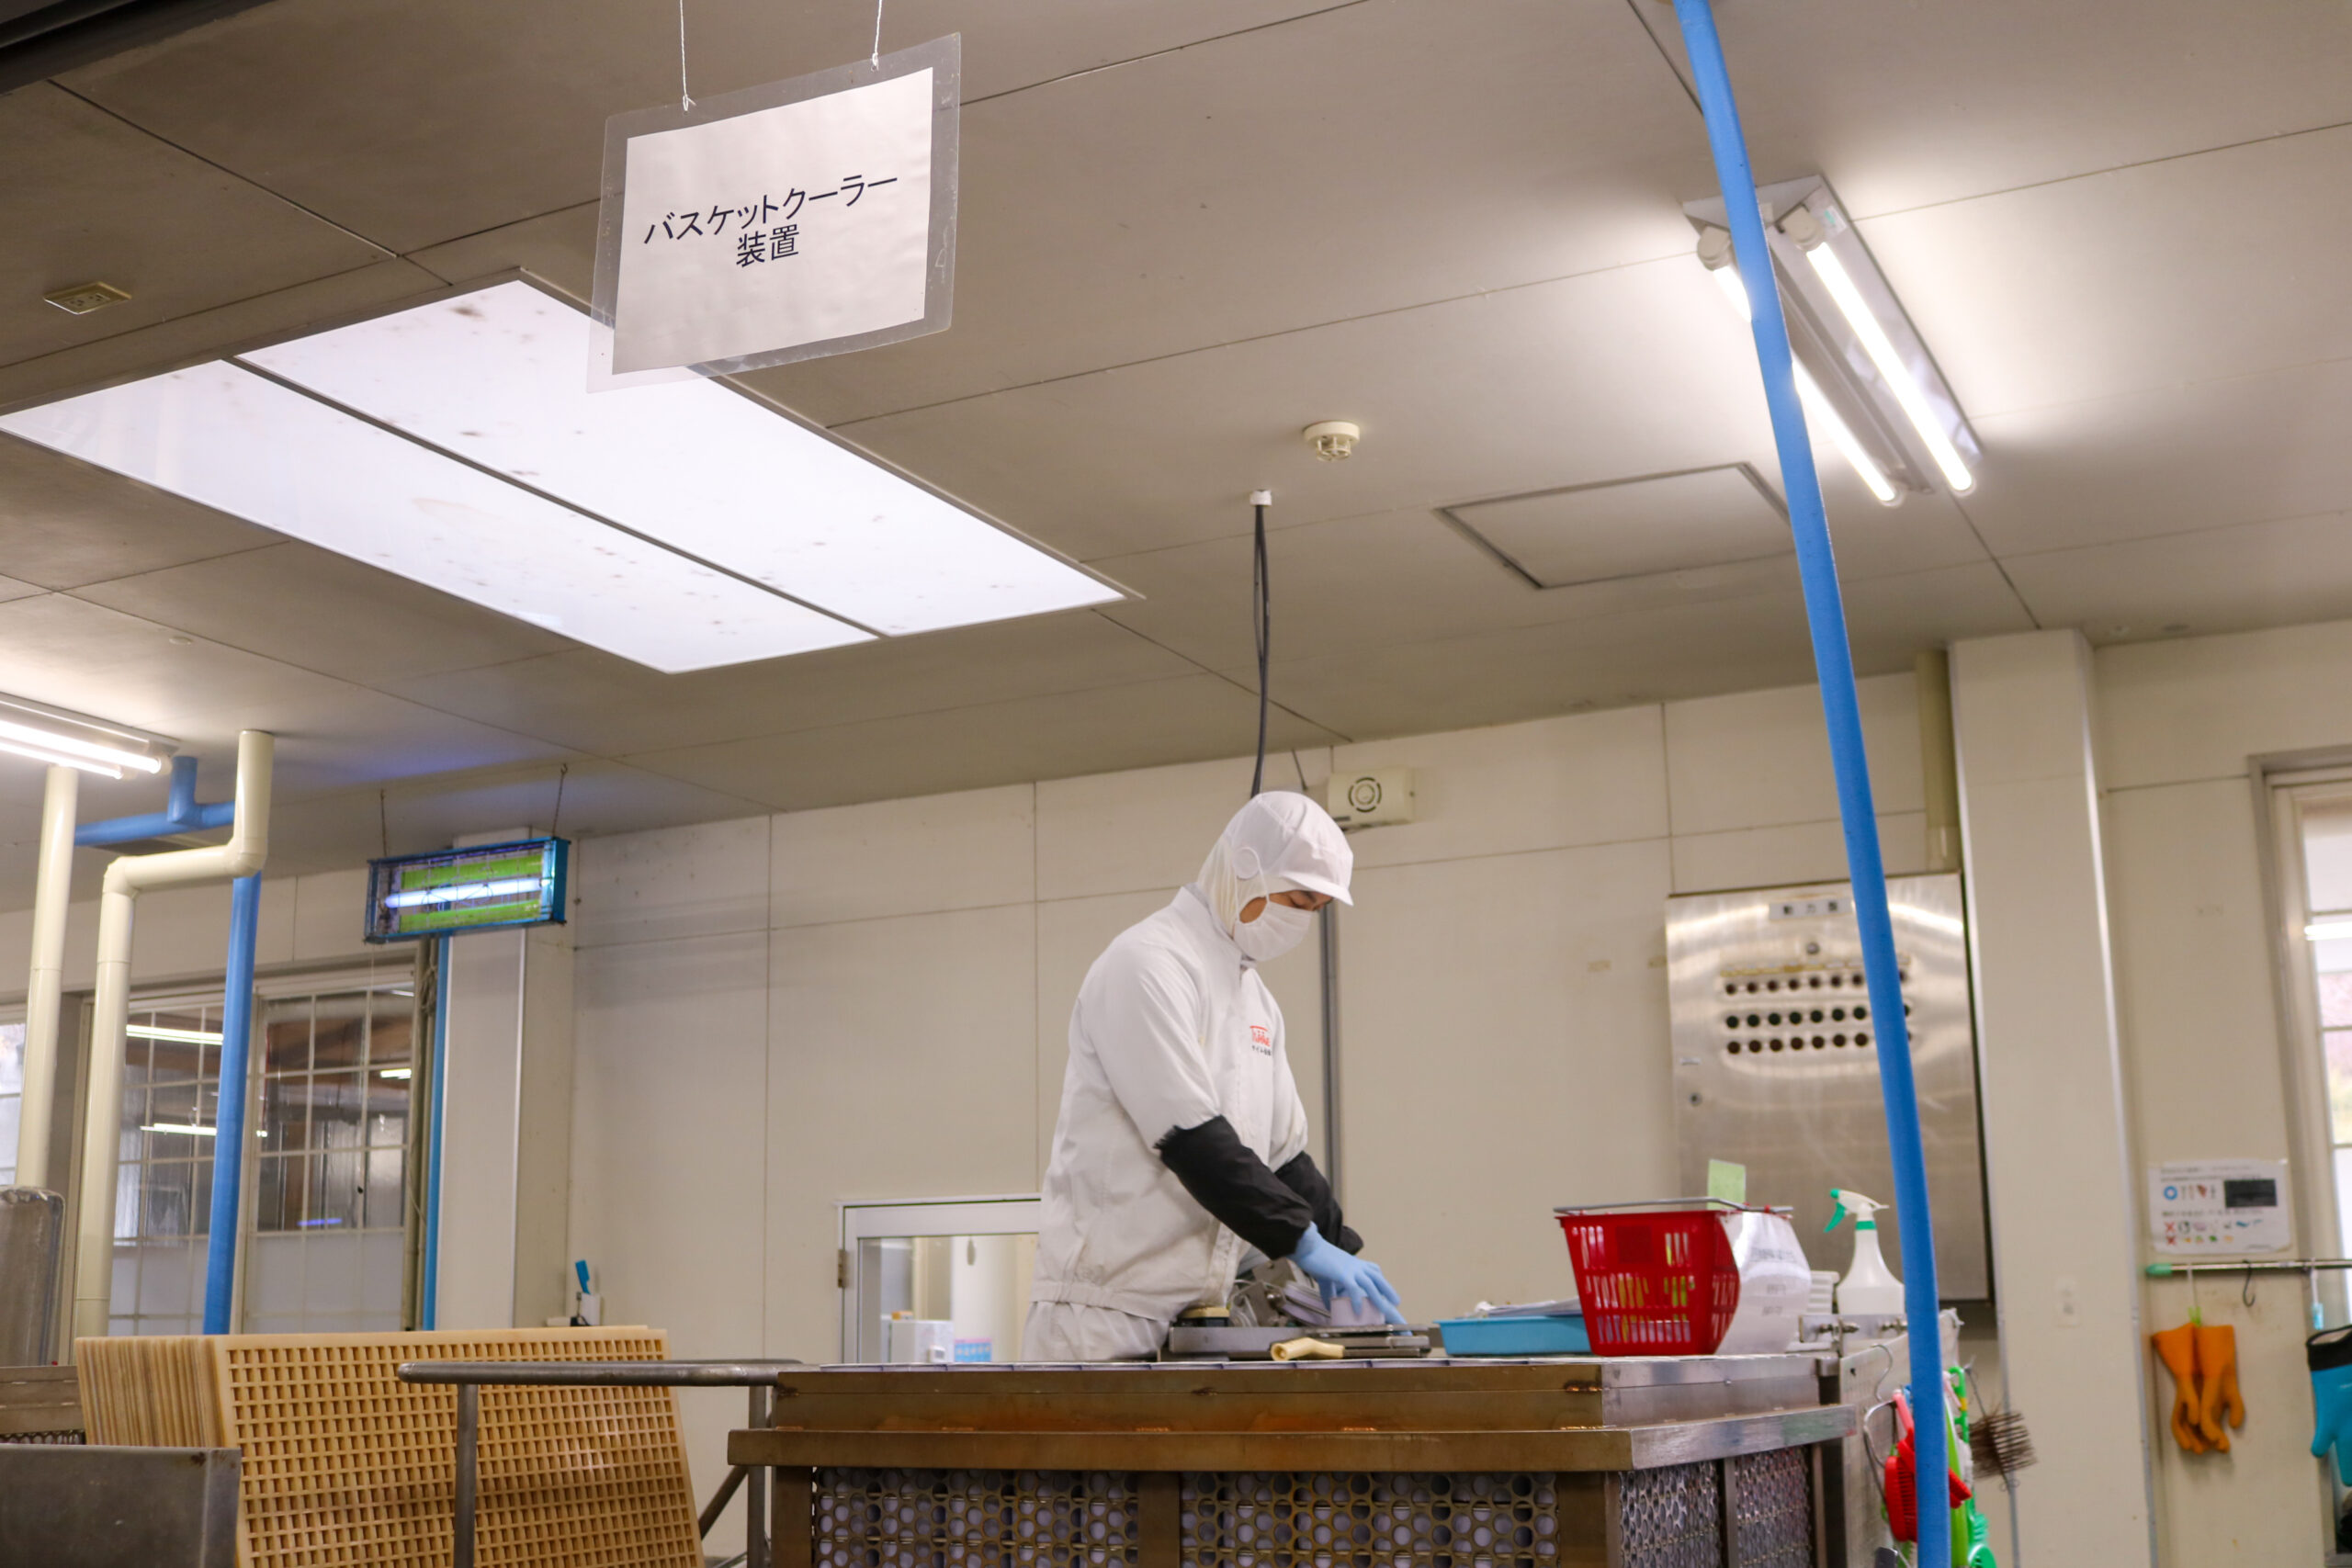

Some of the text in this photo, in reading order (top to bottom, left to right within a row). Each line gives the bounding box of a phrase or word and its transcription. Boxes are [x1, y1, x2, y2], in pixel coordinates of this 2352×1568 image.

[644, 174, 899, 245] バスケットクーラー
[735, 223, 799, 268] 装置
